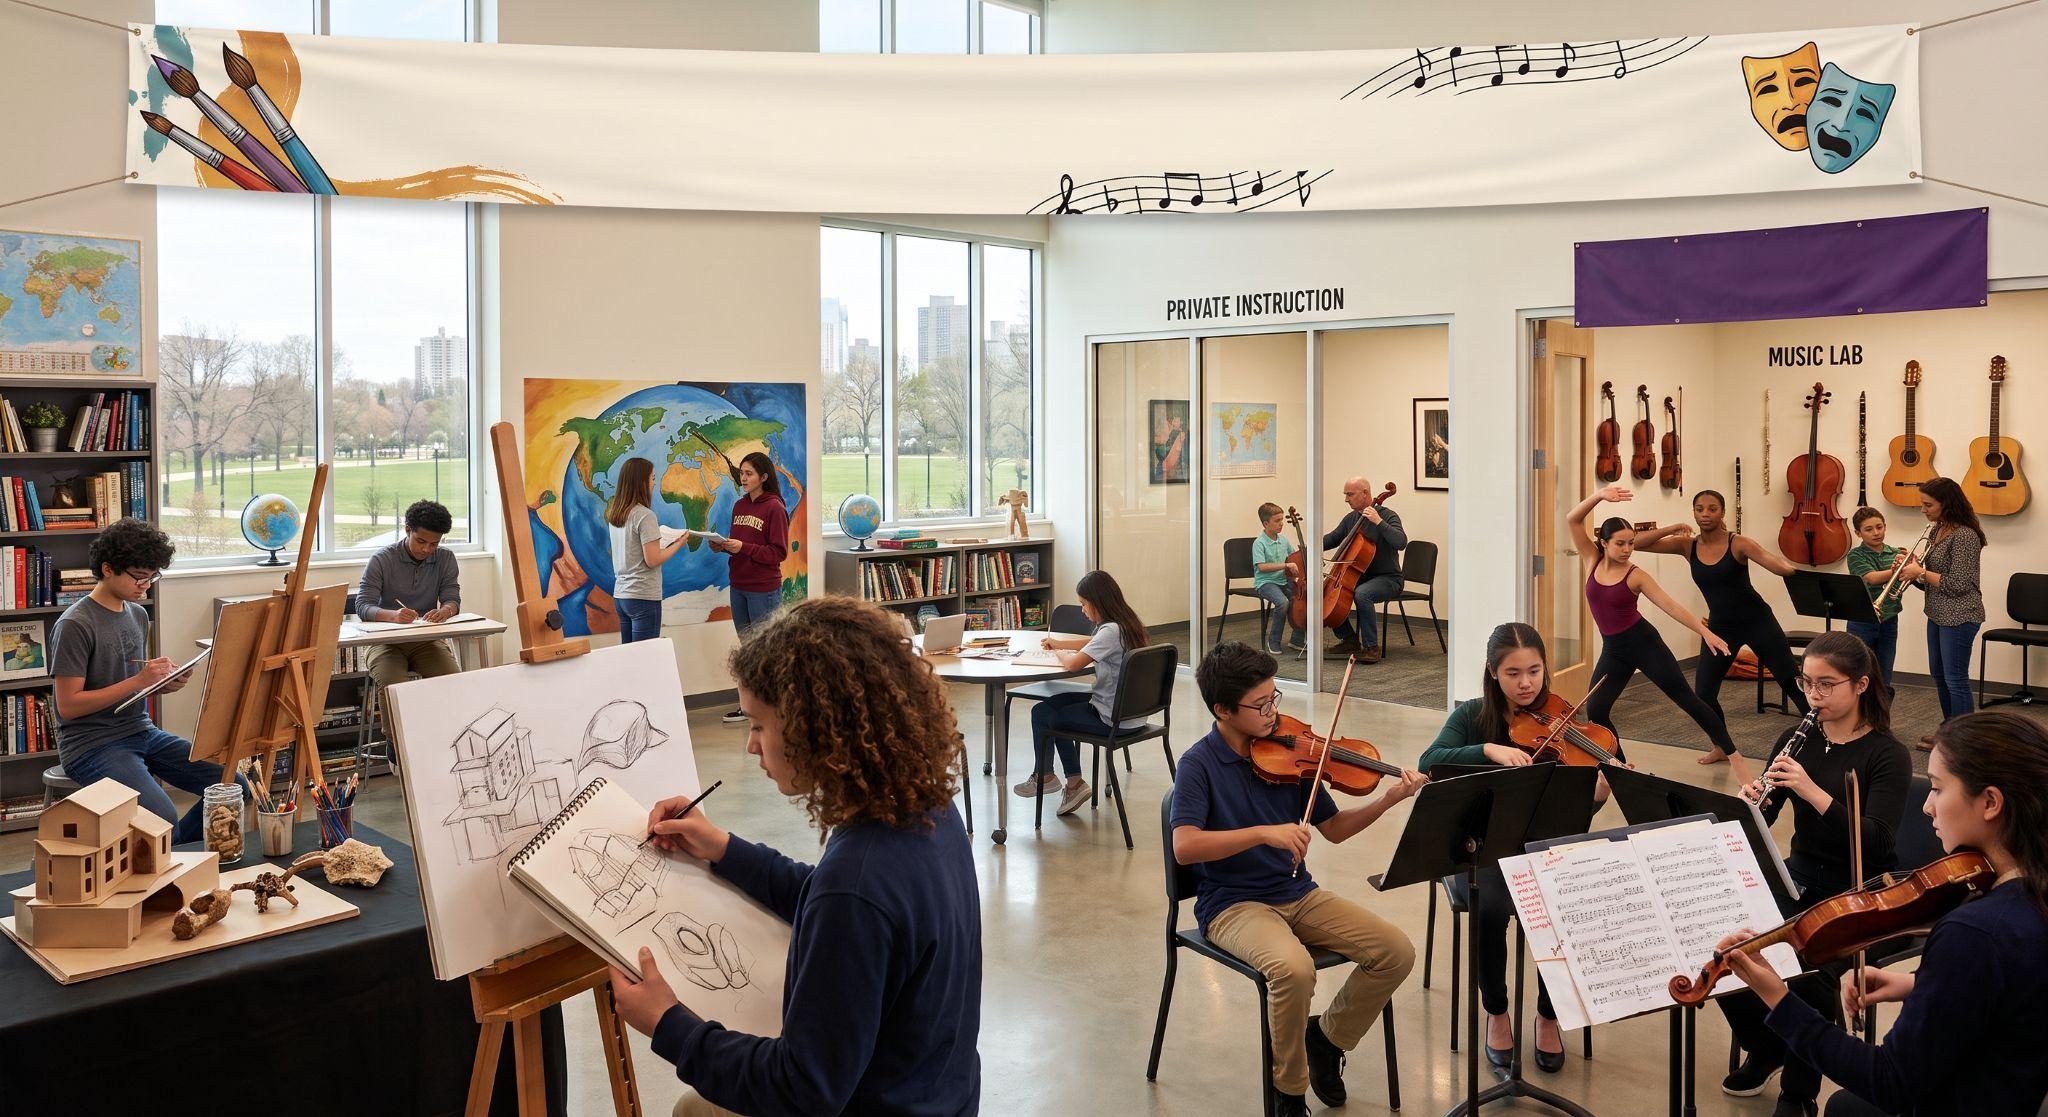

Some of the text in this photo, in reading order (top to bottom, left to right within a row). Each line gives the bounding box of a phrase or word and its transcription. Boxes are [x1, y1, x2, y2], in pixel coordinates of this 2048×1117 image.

[1167, 288, 1344, 321] PRIVATE INSTRUCTION
[1768, 345, 1863, 367] MUSIC LAB
